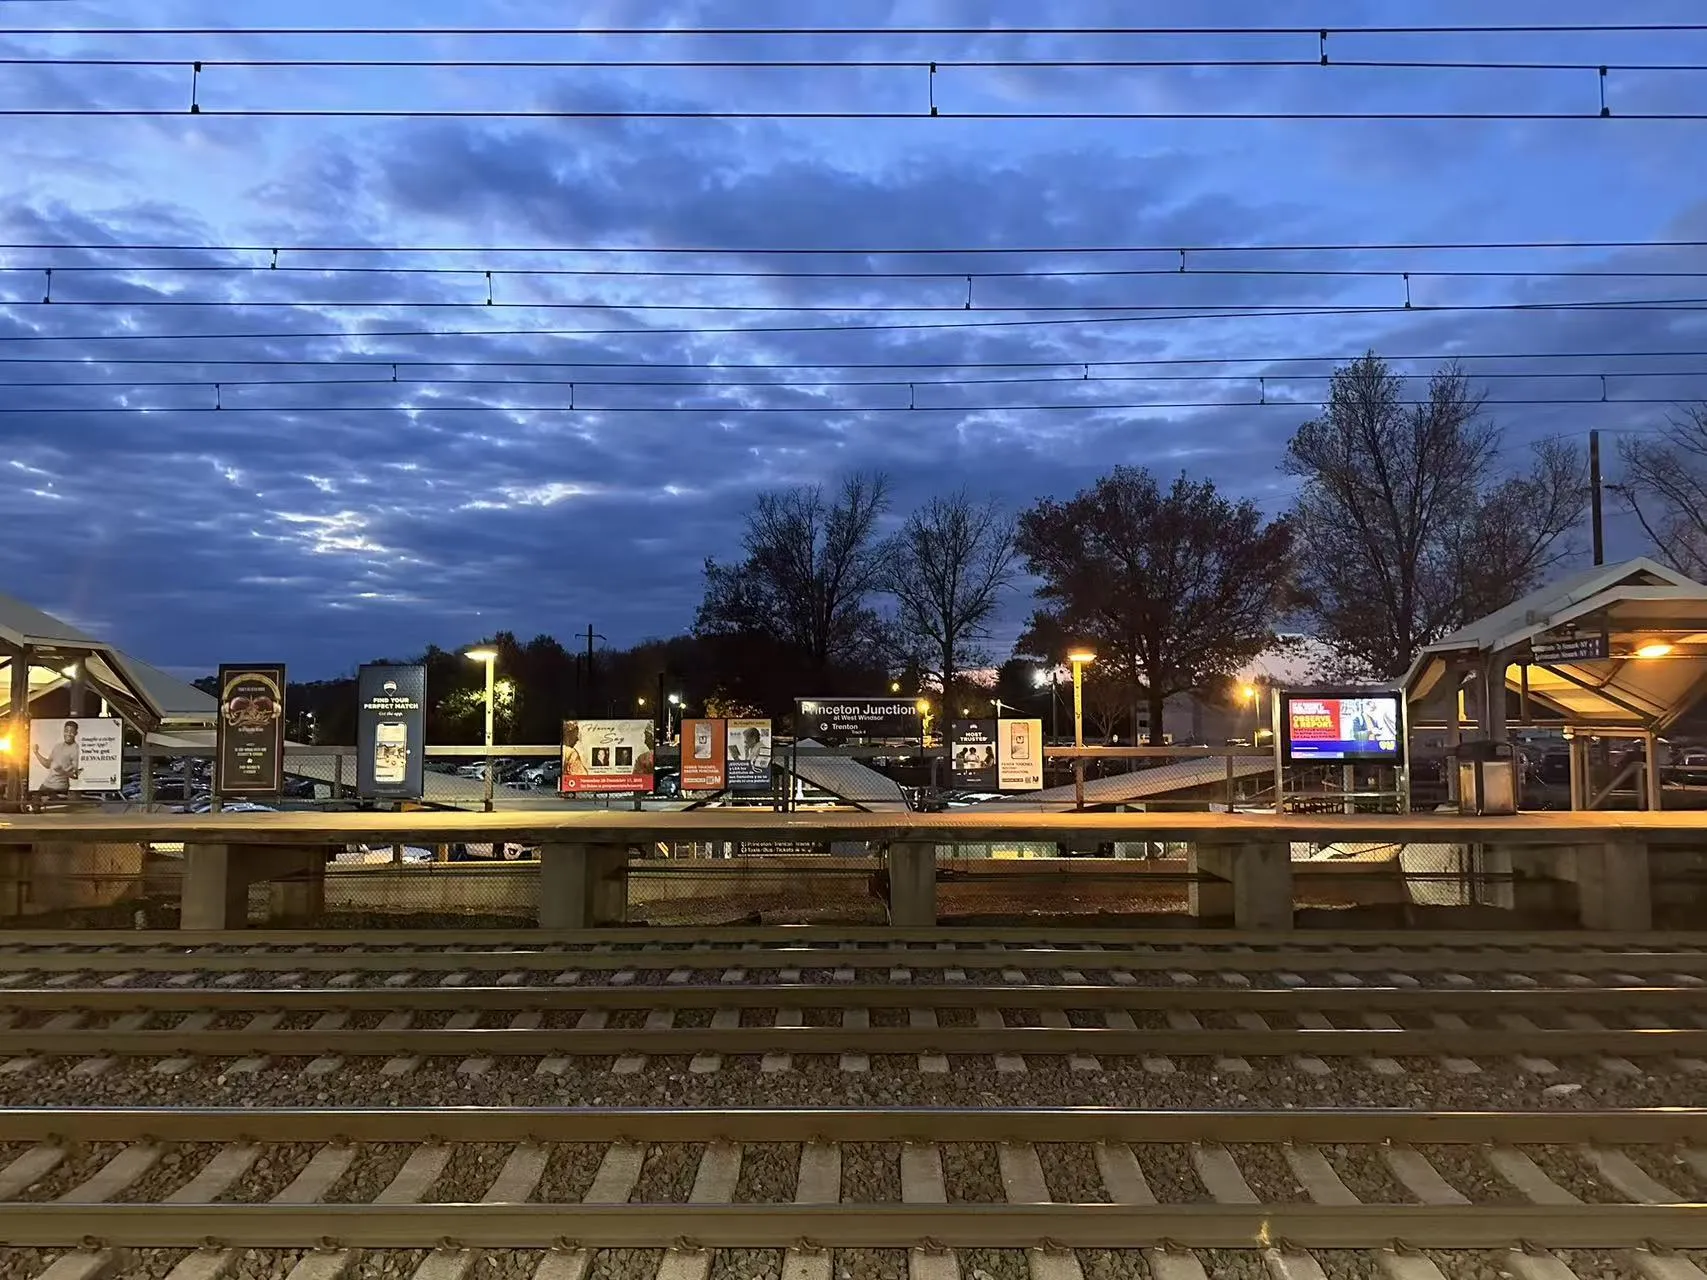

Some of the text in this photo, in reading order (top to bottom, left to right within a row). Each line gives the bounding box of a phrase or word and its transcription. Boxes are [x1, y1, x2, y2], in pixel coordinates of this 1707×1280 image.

[801, 703, 916, 715] Princeton Junction
[600, 733, 625, 744] Say
